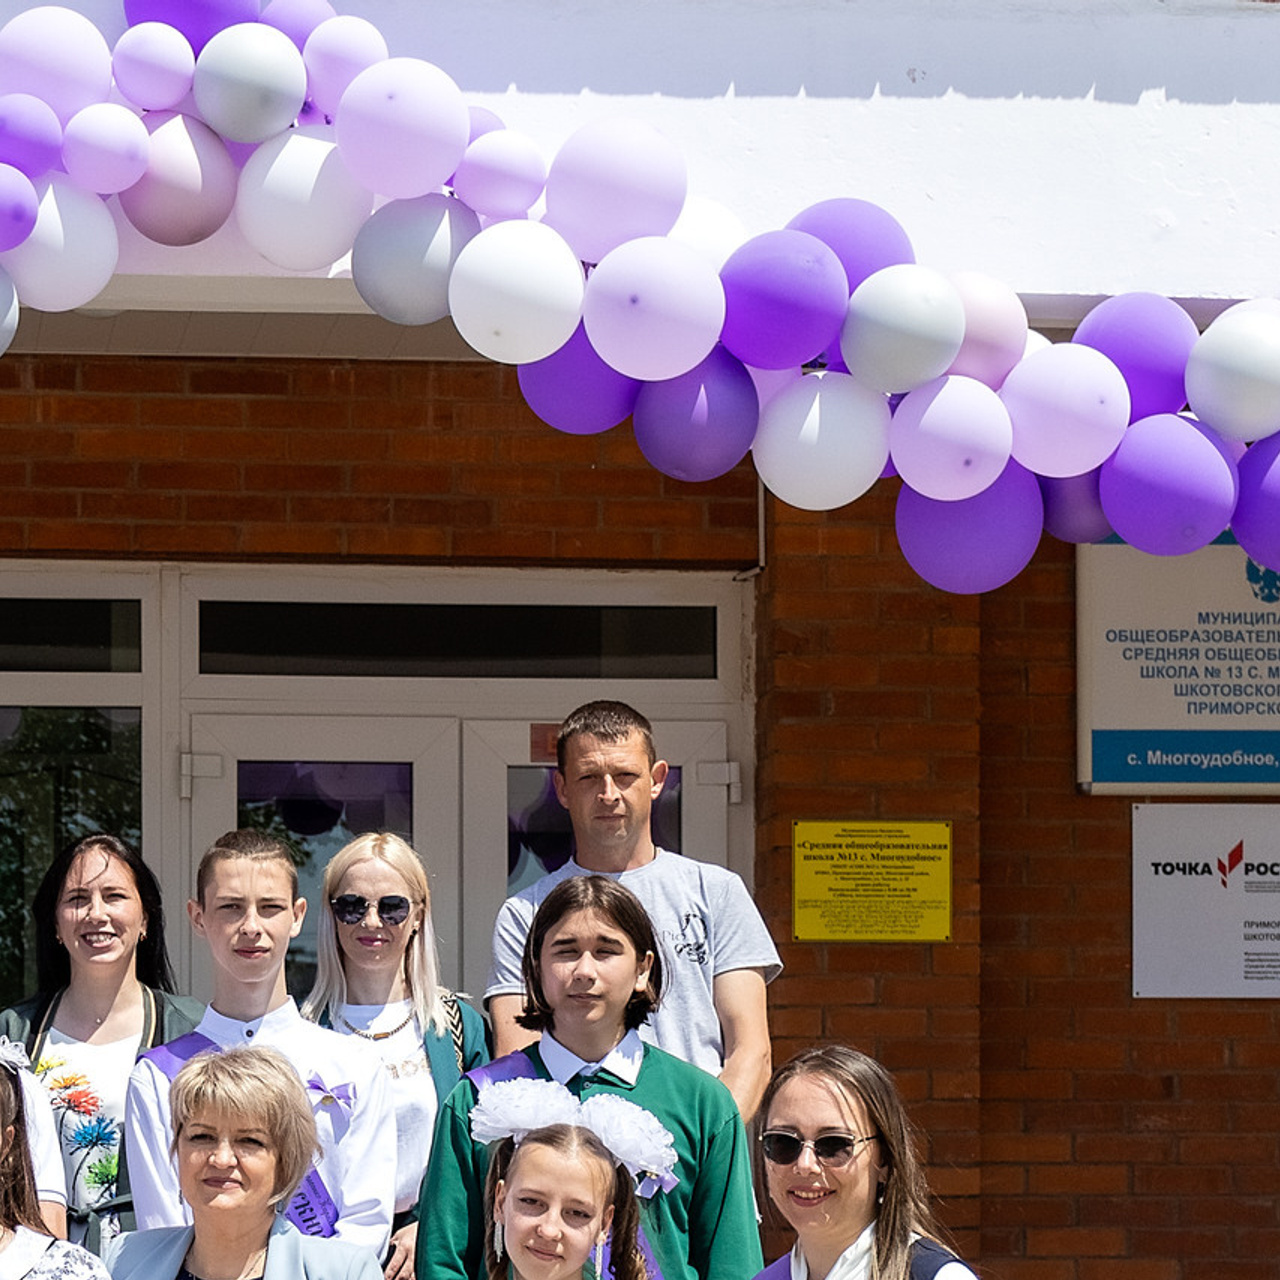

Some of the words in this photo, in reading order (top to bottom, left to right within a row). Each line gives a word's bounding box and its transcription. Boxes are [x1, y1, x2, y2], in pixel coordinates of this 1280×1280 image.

[1122, 648, 1200, 662] СРЕДНЯЯ
[1205, 648, 1280, 663] ОБЩЕОБ
[1140, 666, 1200, 679] ШКОЛА
[1204, 666, 1221, 679] №
[1226, 666, 1243, 679] 13
[1247, 666, 1263, 679] С.
[1173, 684, 1280, 697] ШКОТОВСКО
[1127, 753, 1142, 765] с.
[1147, 750, 1280, 769] Многоудобное,
[1151, 862, 1213, 876] ТОЧКА
